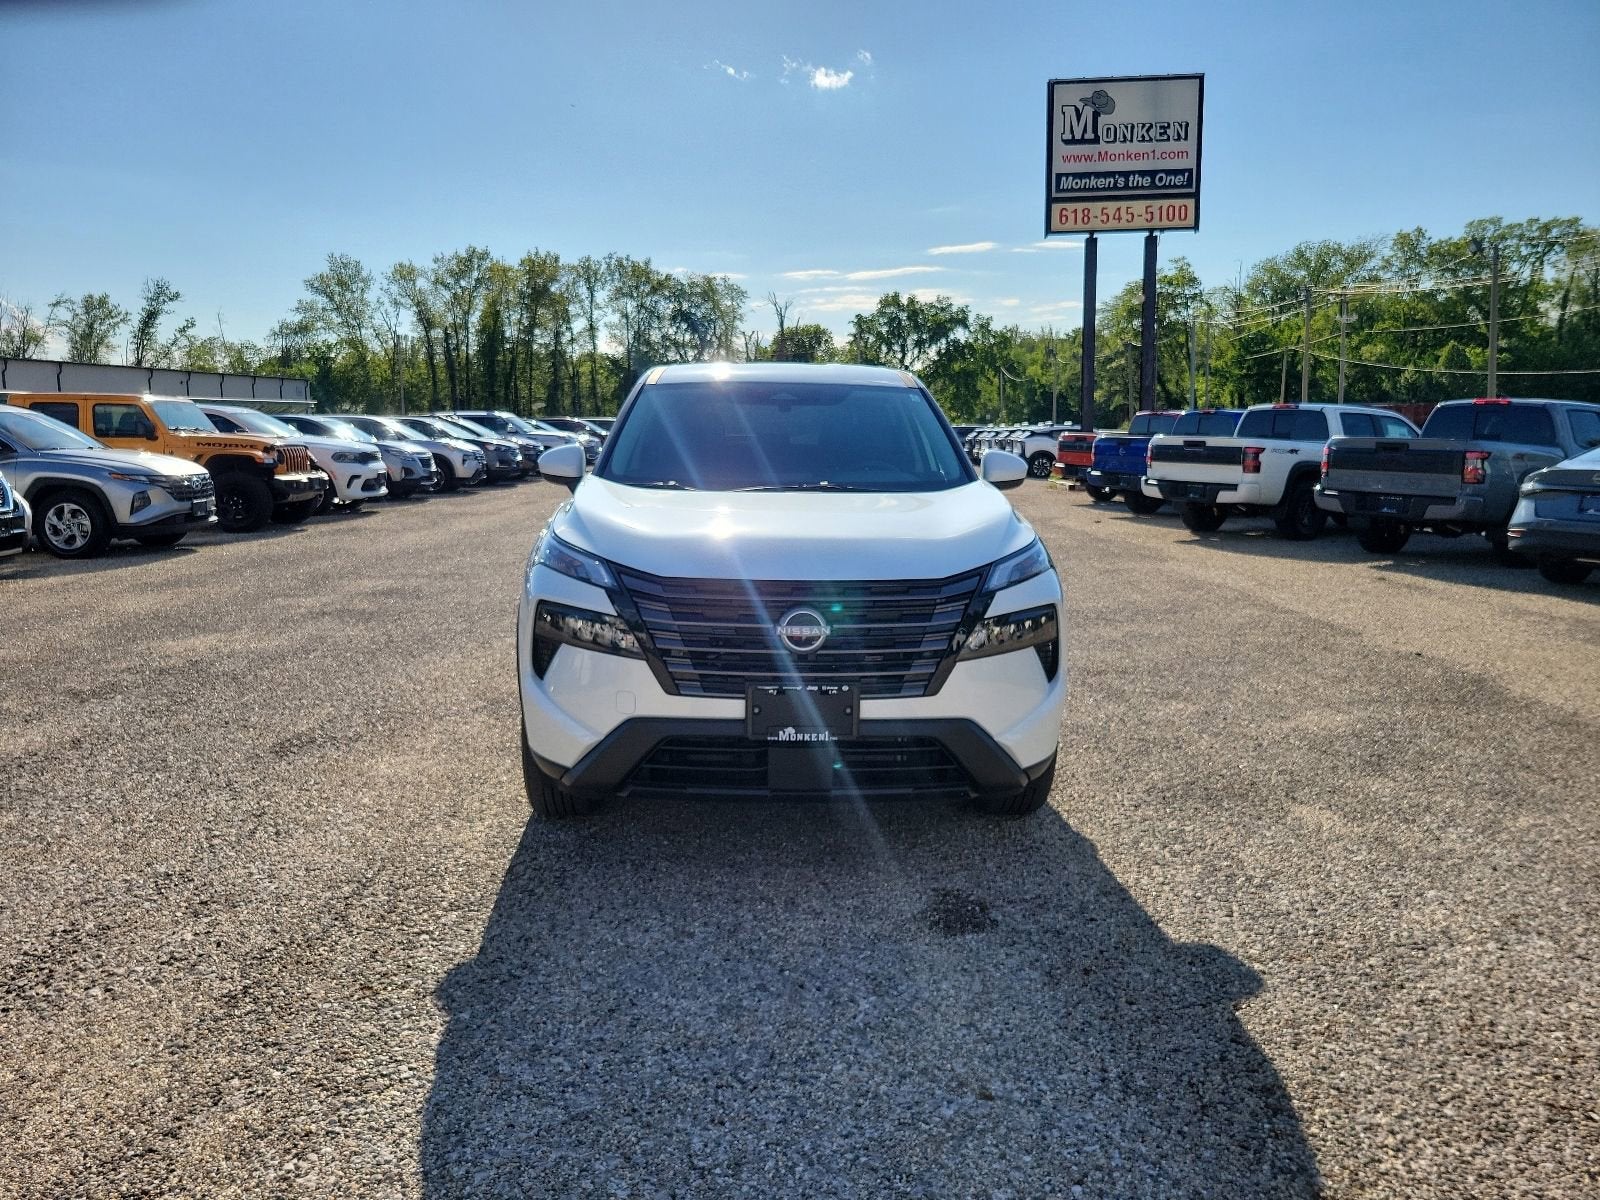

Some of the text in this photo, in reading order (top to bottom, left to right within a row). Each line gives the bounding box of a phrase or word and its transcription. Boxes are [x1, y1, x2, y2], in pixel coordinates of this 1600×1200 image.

[1061, 105, 1189, 145] MONKEN
[1062, 150, 1189, 164] www.Monken1.com
[1060, 172, 1189, 190] Monken's the One!
[1058, 204, 1188, 225] 618-545-5100
[777, 627, 829, 635] NISSAN
